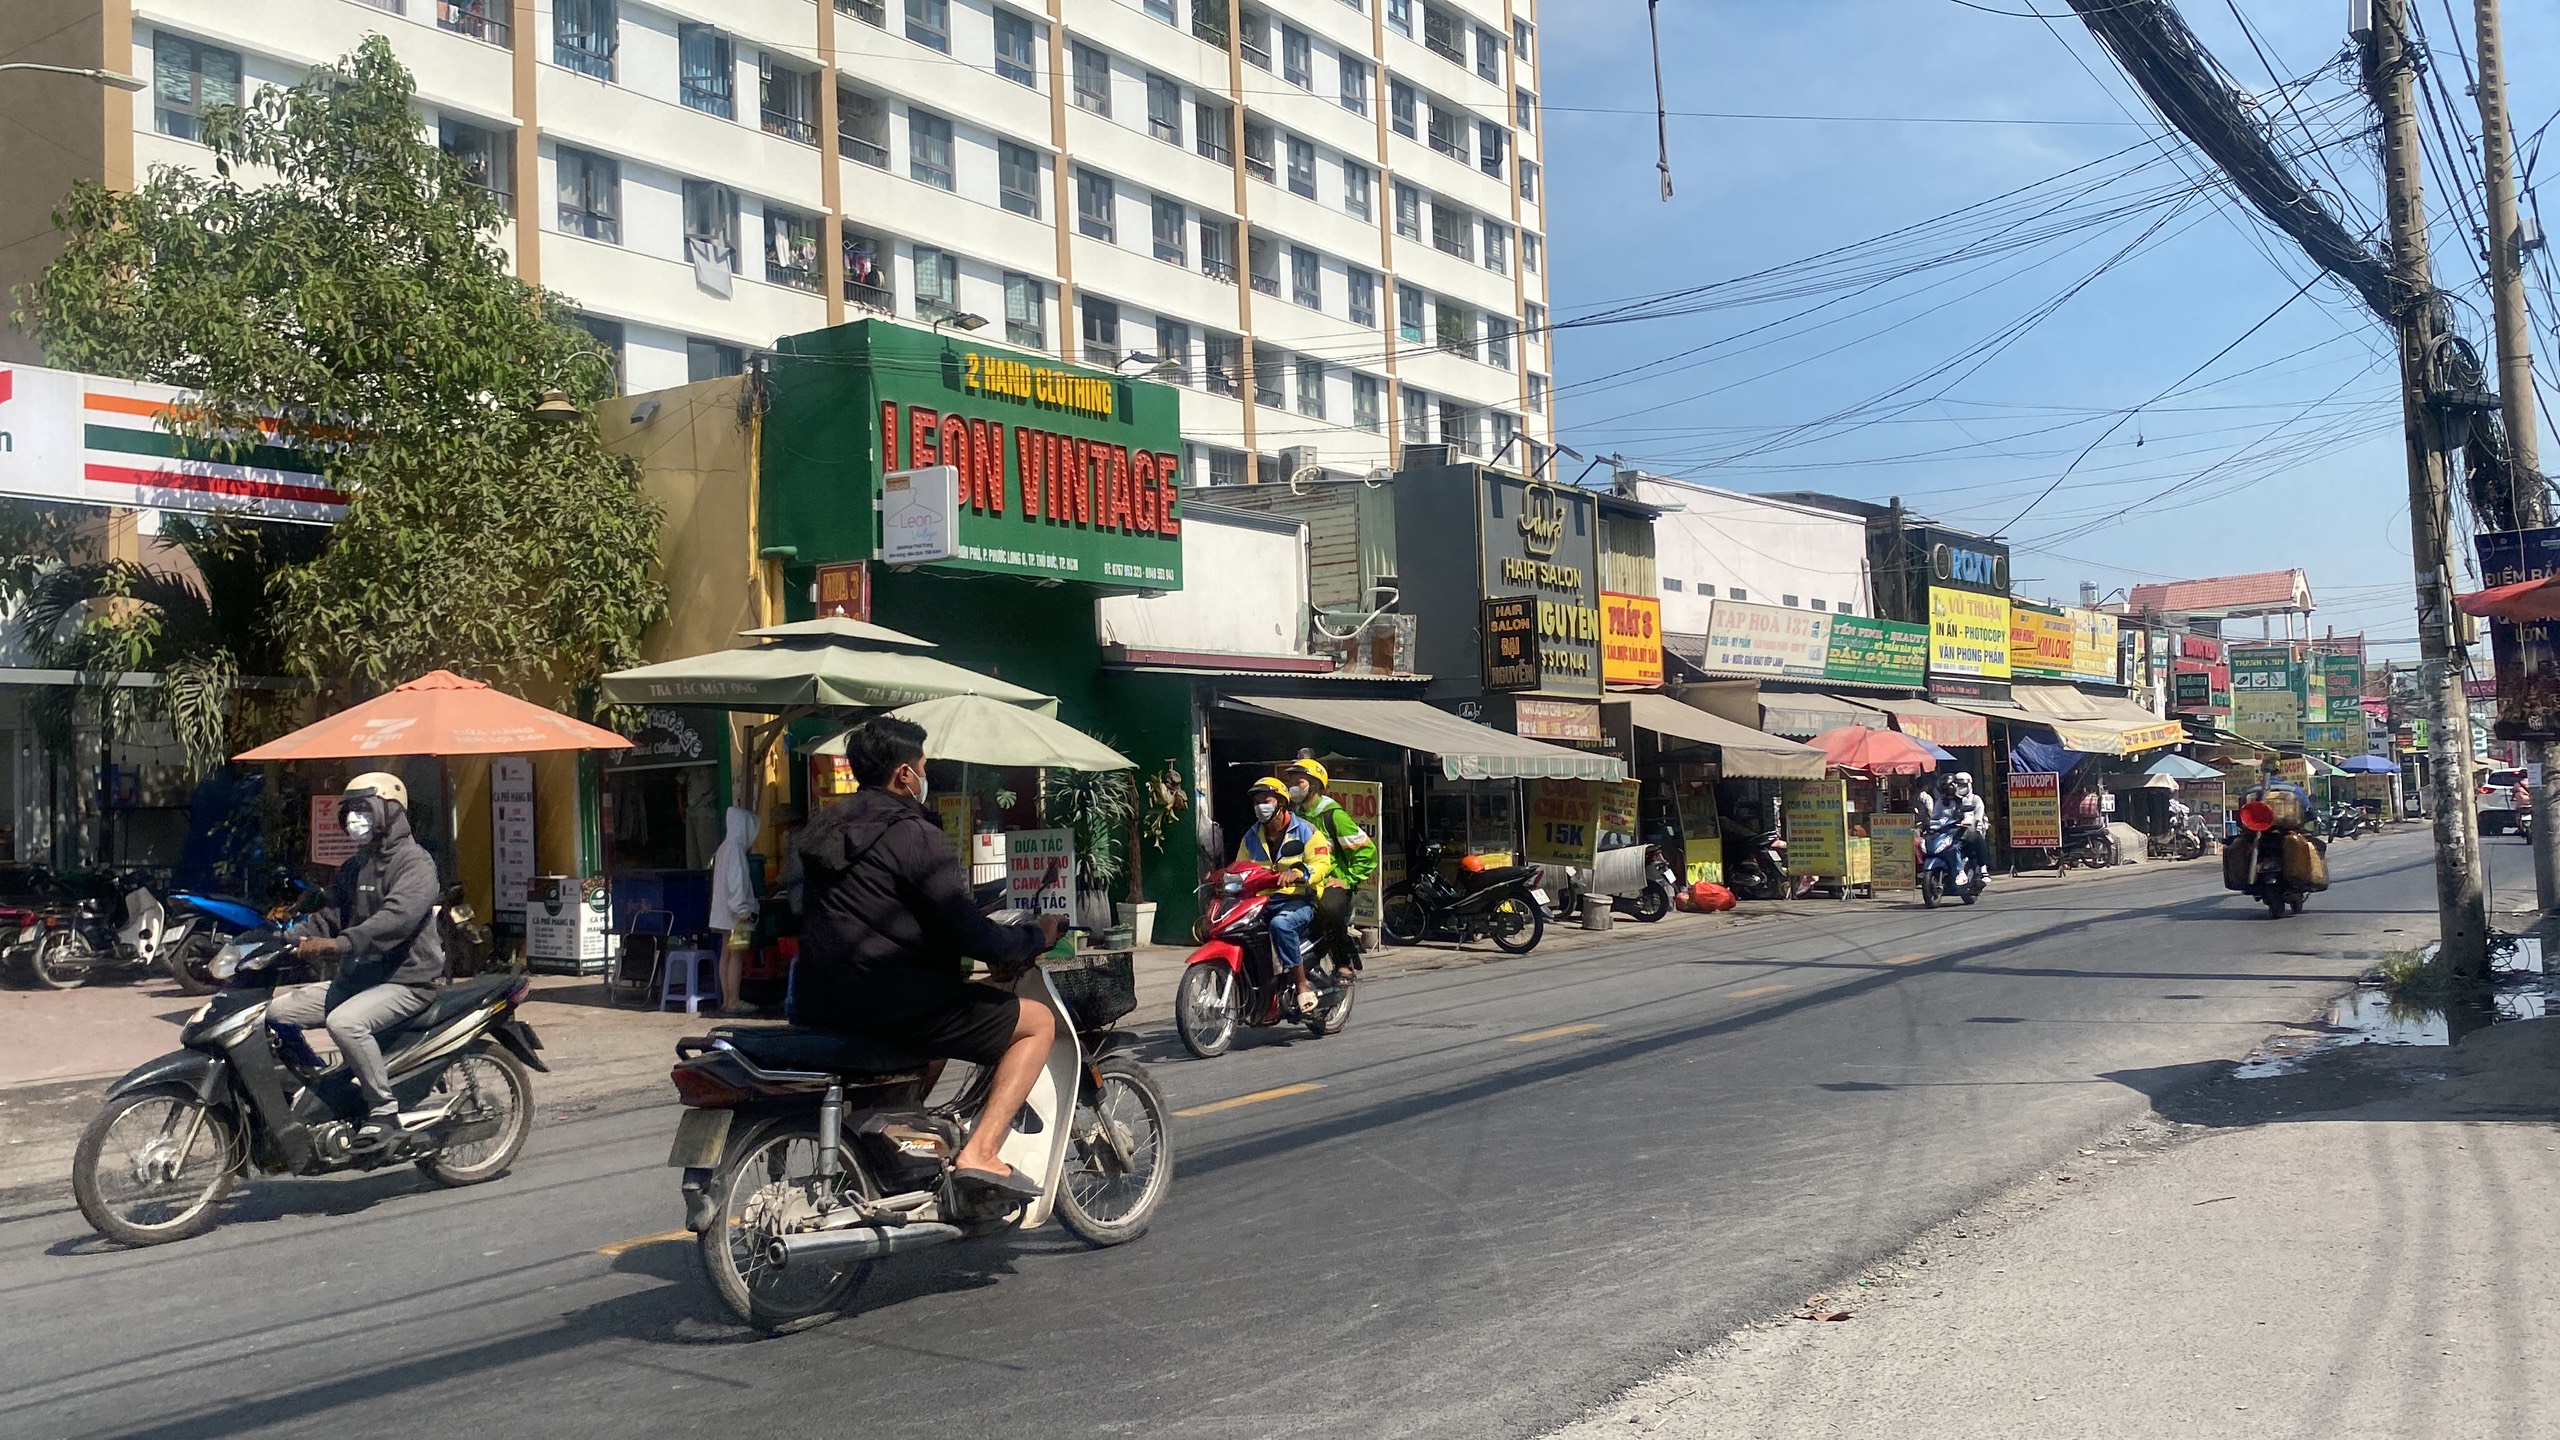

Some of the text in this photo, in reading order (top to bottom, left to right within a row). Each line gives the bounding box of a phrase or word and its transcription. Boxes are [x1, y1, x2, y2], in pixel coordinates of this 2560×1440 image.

[965, 353, 1112, 415] 2 HAND CLOTHING
[1014, 426, 1181, 535] VINTAGE
[900, 513, 933, 529] Leon
[1505, 557, 1582, 589] HAIR SALON
[1951, 547, 1993, 585] ROXY
[822, 570, 860, 602] MUA 3
[1495, 603, 1523, 618] HAIR
[1608, 600, 1641, 637] PHÁT
[1490, 617, 1531, 633] SALON
[1785, 615, 1810, 636] 137
[1936, 621, 1945, 637] IN
[1946, 619, 1958, 638] ẤN
[1964, 625, 2006, 644] PHOTOCOPY
[1938, 643, 1955, 660] VĂN
[1956, 643, 1982, 662] PHÒNG
[1983, 645, 2005, 666] PHẨM
[2037, 636, 2052, 657] KIM
[2050, 638, 2071, 660] LONG
[649, 683, 673, 698] TRÀ
[864, 684, 887, 699] TRÀ
[2011, 774, 2055, 788] PHOTOCOPY
[1352, 787, 1378, 818] BÒ
[1533, 800, 1591, 823] CHAY
[1543, 822, 1584, 846] 15K
[1010, 854, 1030, 871] TRÀ
[1012, 877, 1041, 891] CAM
[1042, 891, 1067, 909] TẮC
